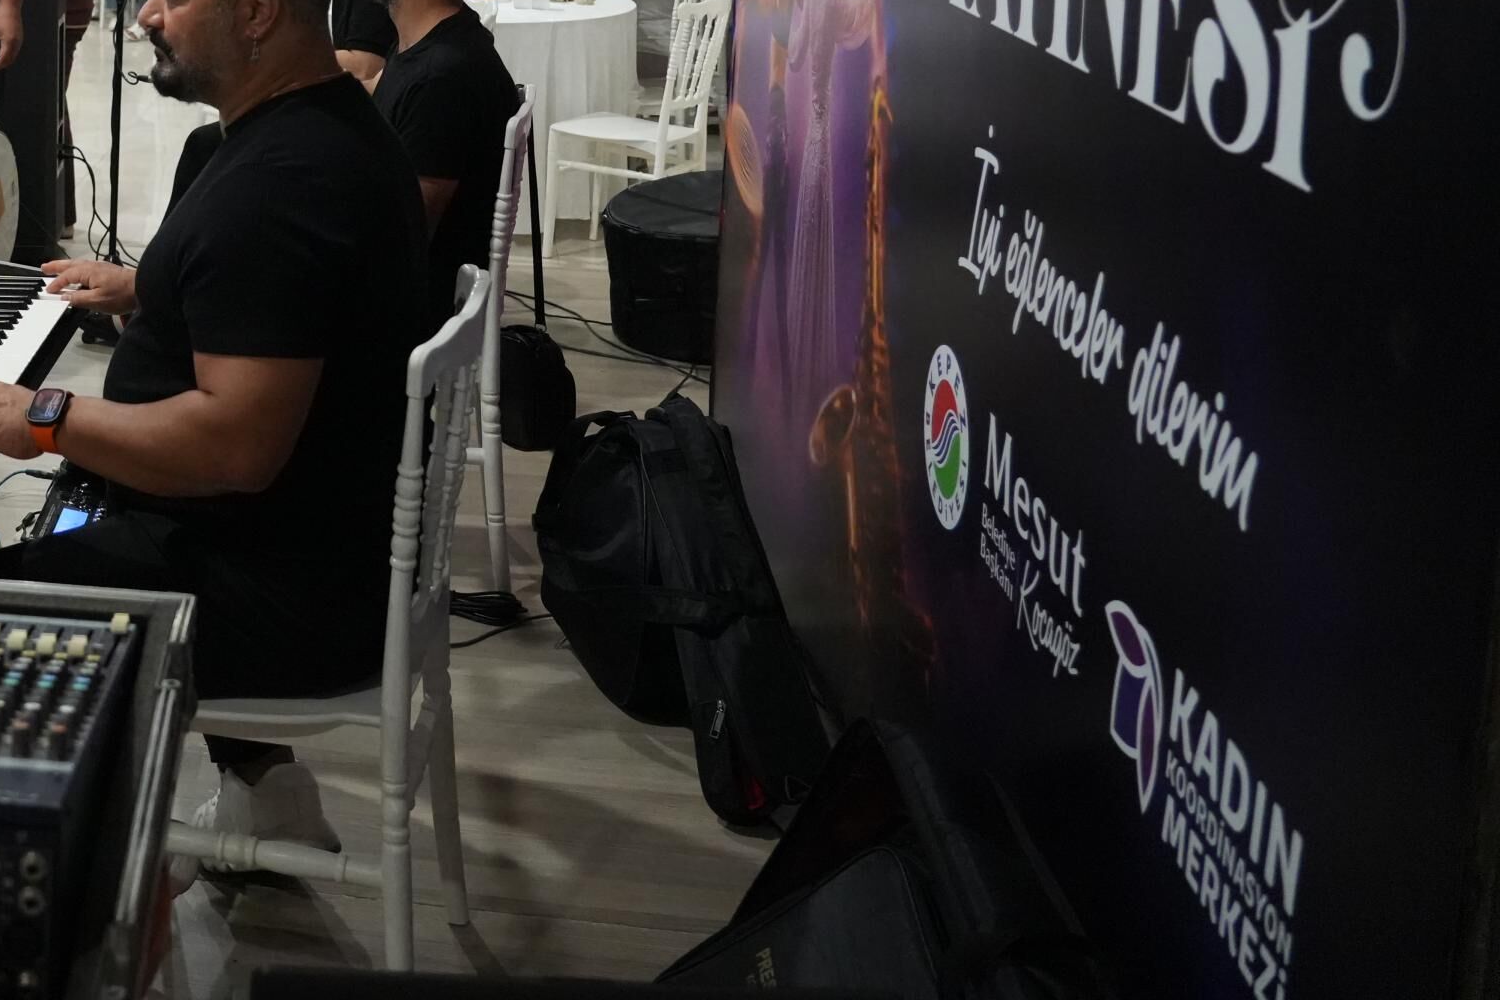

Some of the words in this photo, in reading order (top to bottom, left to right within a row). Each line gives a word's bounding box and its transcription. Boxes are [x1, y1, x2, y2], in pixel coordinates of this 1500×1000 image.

[928, 353, 967, 433] KEPEZ
[1005, 209, 1125, 385] eğlenceler
[1127, 321, 1258, 532] dilerim
[979, 532, 1014, 602] Başkanı
[981, 502, 1016, 571] Belediye
[984, 411, 1086, 618] Mesut
[1016, 560, 1081, 678] Kocagöz
[1169, 667, 1304, 918] KADIN
